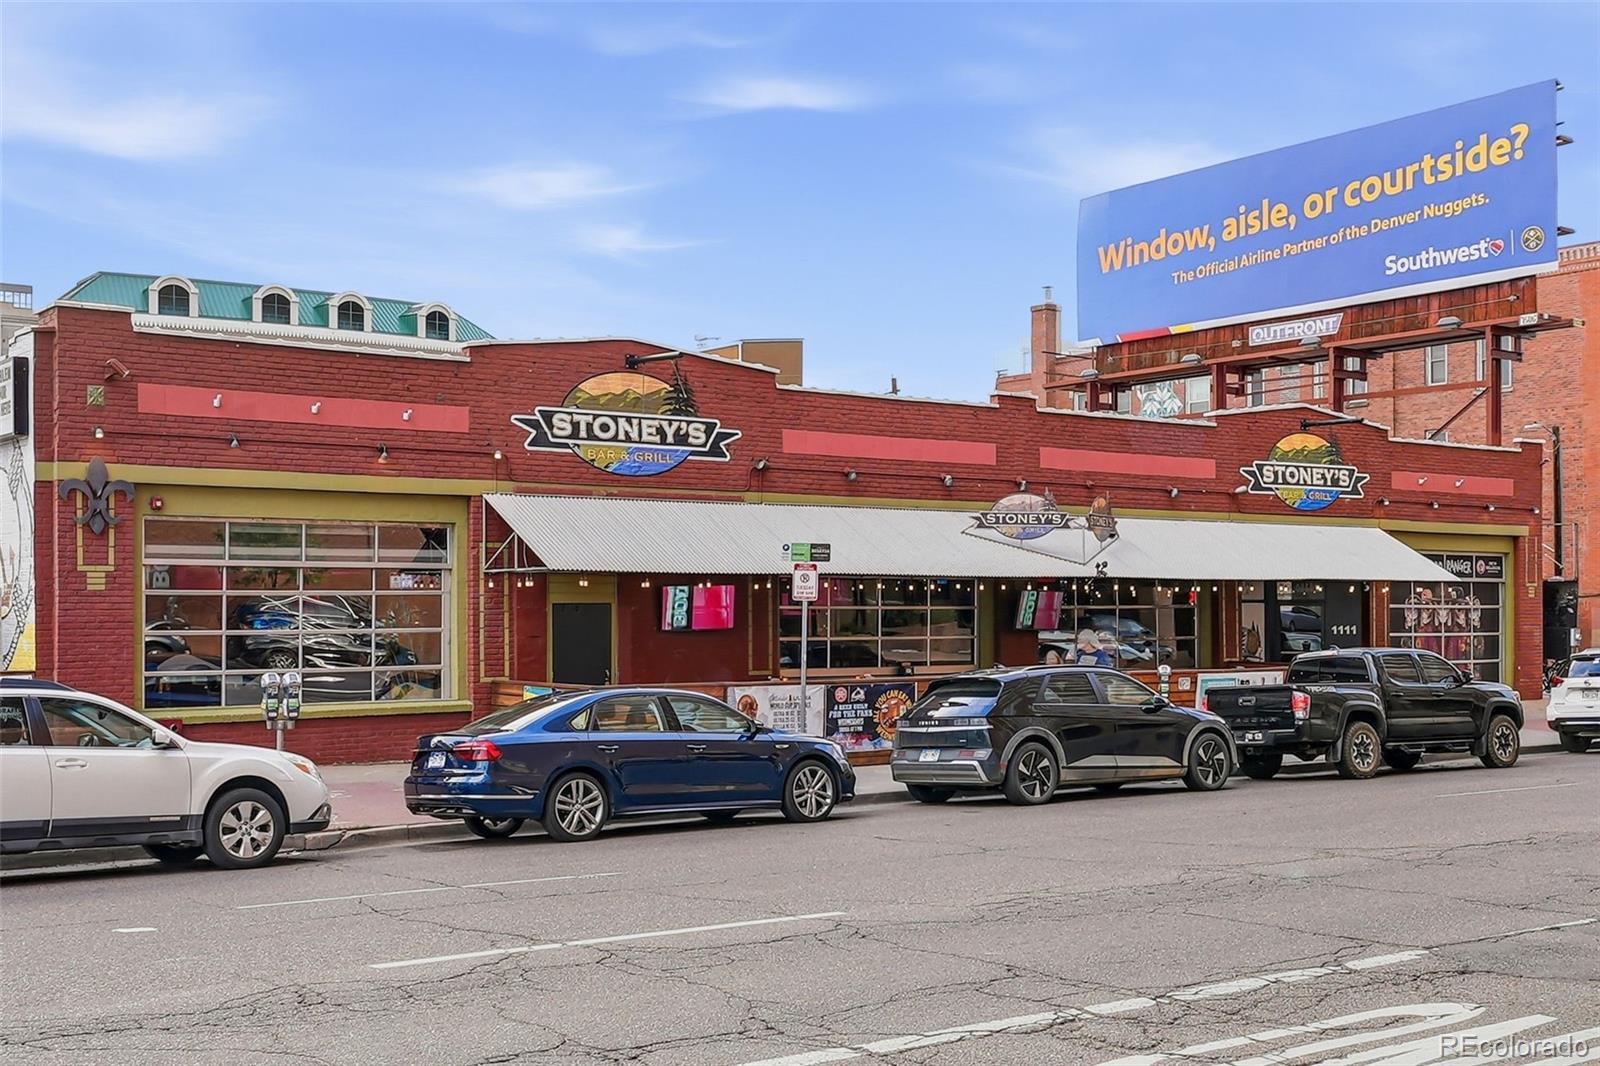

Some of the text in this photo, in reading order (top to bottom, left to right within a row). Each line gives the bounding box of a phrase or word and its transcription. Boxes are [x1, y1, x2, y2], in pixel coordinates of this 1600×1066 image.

[1098, 123, 1530, 274] Window, aisle, or courtside?
[1172, 193, 1489, 284] The Official Airline Partner of the Denver Nuggets.
[1385, 238, 1489, 276] Southwest
[1253, 316, 1337, 342] OUTFRONT
[551, 413, 707, 446] STONEY'S
[588, 450, 674, 464] BAR & GRILL
[1262, 465, 1350, 488] STONEY'S
[1308, 491, 1332, 501] GRILL
[986, 513, 1062, 526] STONEY'S
[1331, 624, 1357, 635] 1111
